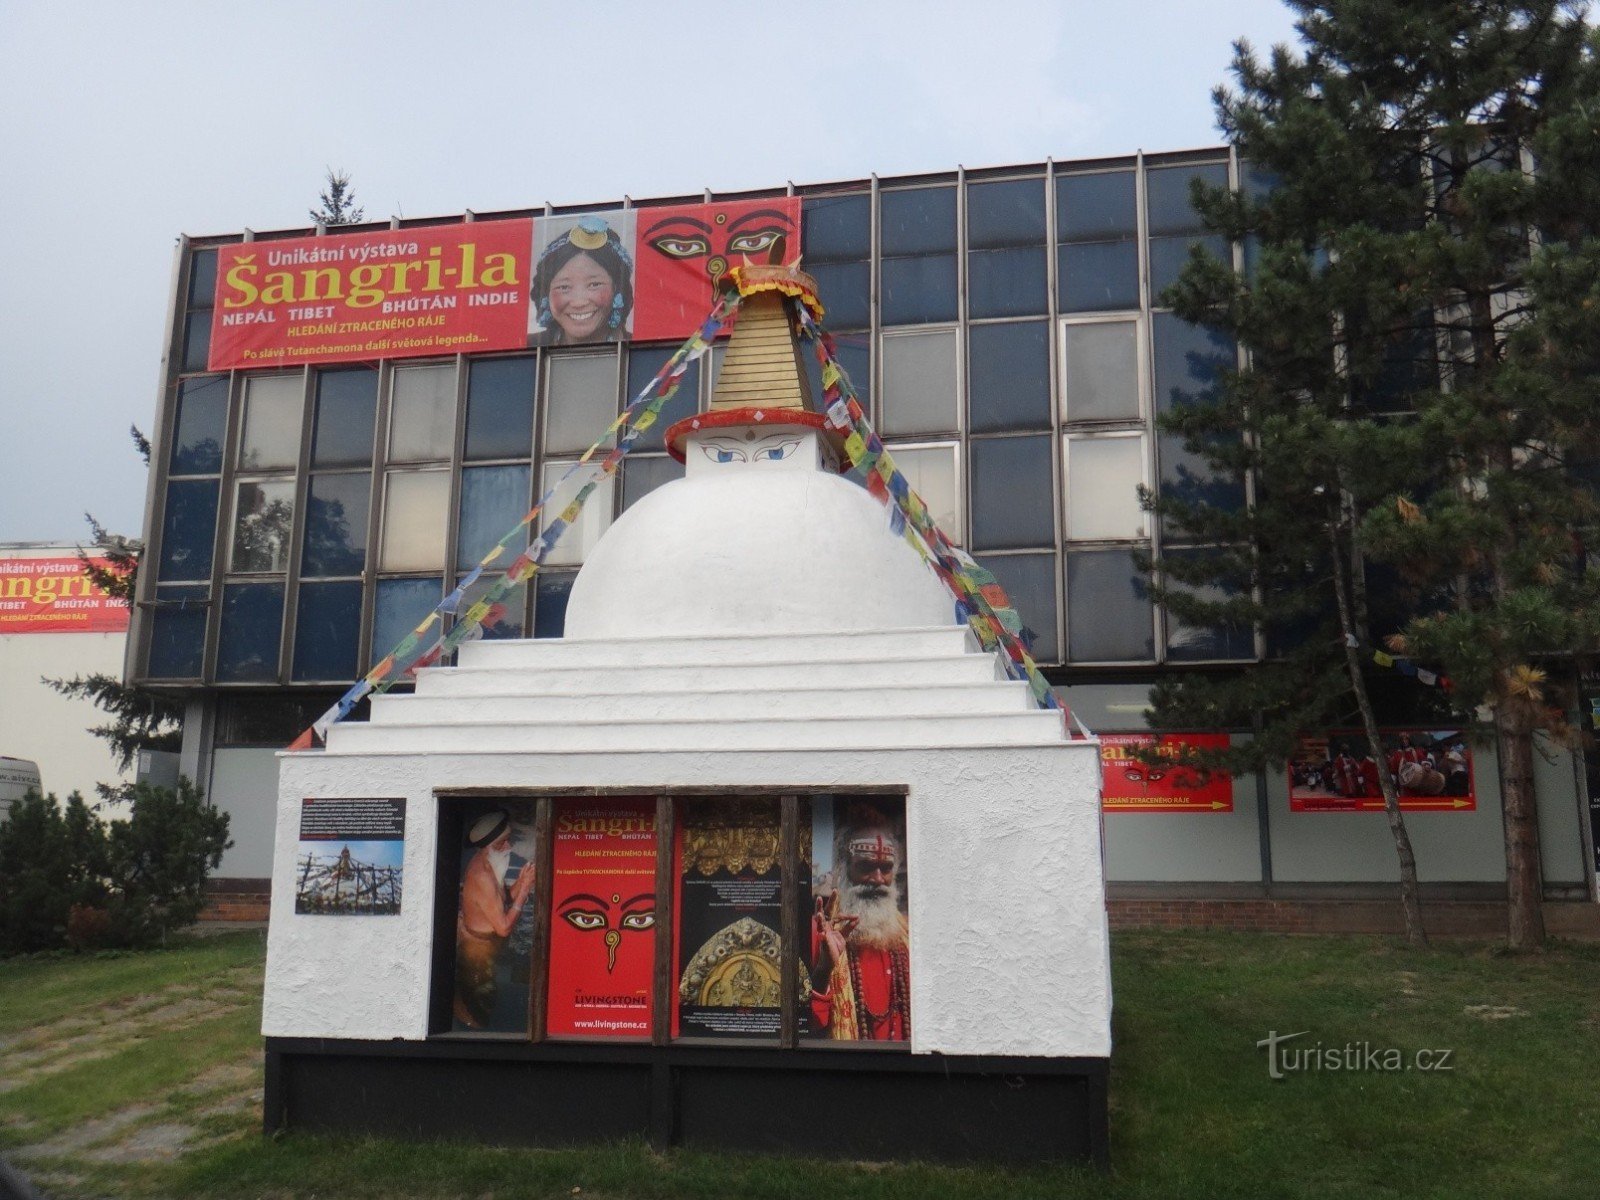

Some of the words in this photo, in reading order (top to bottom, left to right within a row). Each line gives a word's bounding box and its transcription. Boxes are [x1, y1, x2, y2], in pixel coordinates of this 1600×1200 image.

[268, 245, 345, 267] Unikátní
[349, 242, 419, 263] výstava
[223, 243, 520, 308] Šangri-la
[222, 308, 276, 326] NEPÁL
[288, 306, 335, 321] TIBET
[381, 295, 457, 314] BHÚTÁN
[468, 291, 519, 307] INDIE
[287, 322, 337, 337] HLEDÁNÍ
[338, 316, 415, 334] ZTRACENÉHO
[417, 314, 446, 328] RÁJE
[243, 350, 258, 360] Po
[259, 347, 285, 358] slávě
[287, 344, 363, 356] Tutanchamona
[365, 338, 390, 351] další
[392, 336, 433, 349] světová
[435, 333, 488, 347] legenda...
[37, 563, 79, 575] výstava
[54, 599, 99, 609] BHÚTÁN
[574, 849, 602, 857] HLEDÁNÍ
[602, 849, 643, 857] ZTRACENÉHO
[575, 995, 647, 1005] LIVINGSTONE
[574, 1020, 647, 1030] www.livingstone.cz
